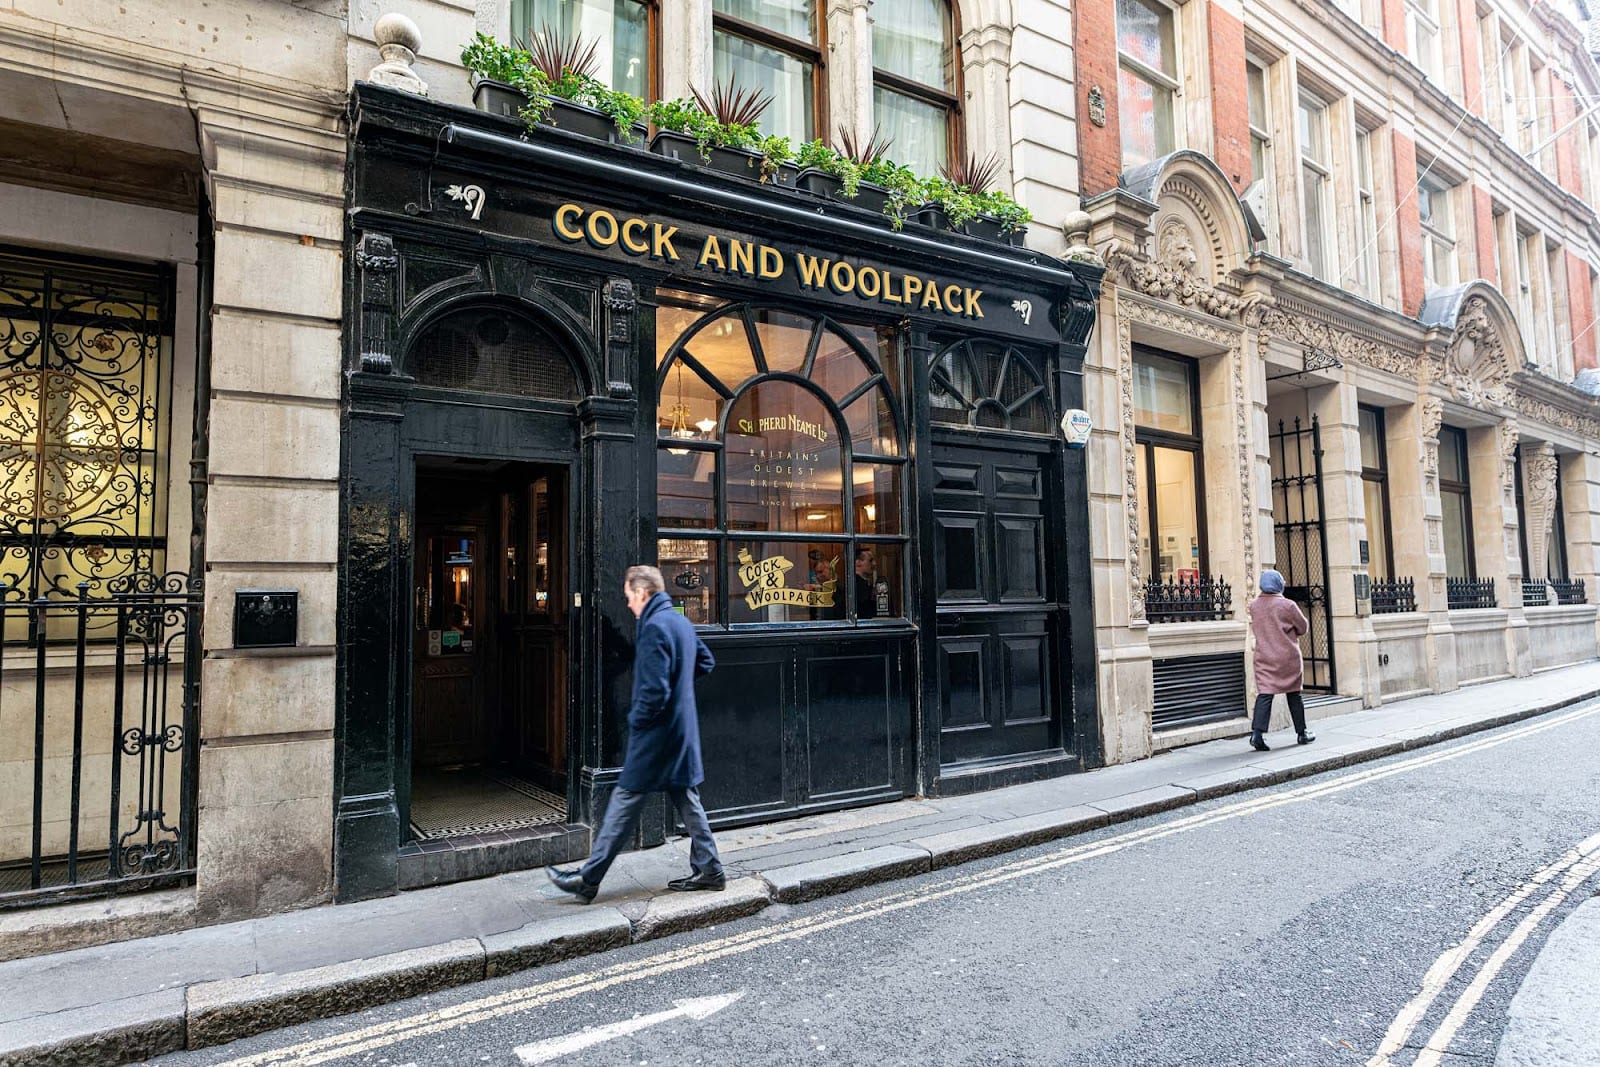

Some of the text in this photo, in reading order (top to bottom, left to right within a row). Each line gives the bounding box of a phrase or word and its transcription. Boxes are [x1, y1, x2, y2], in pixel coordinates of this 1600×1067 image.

[553, 203, 985, 318] COCK AND WOOLPACK
[738, 416, 787, 437] SHPHERD
[754, 464, 815, 476] OLDEST
[746, 558, 781, 581] COCK
[766, 572, 778, 588] &
[750, 587, 825, 606] WOOLPACK
